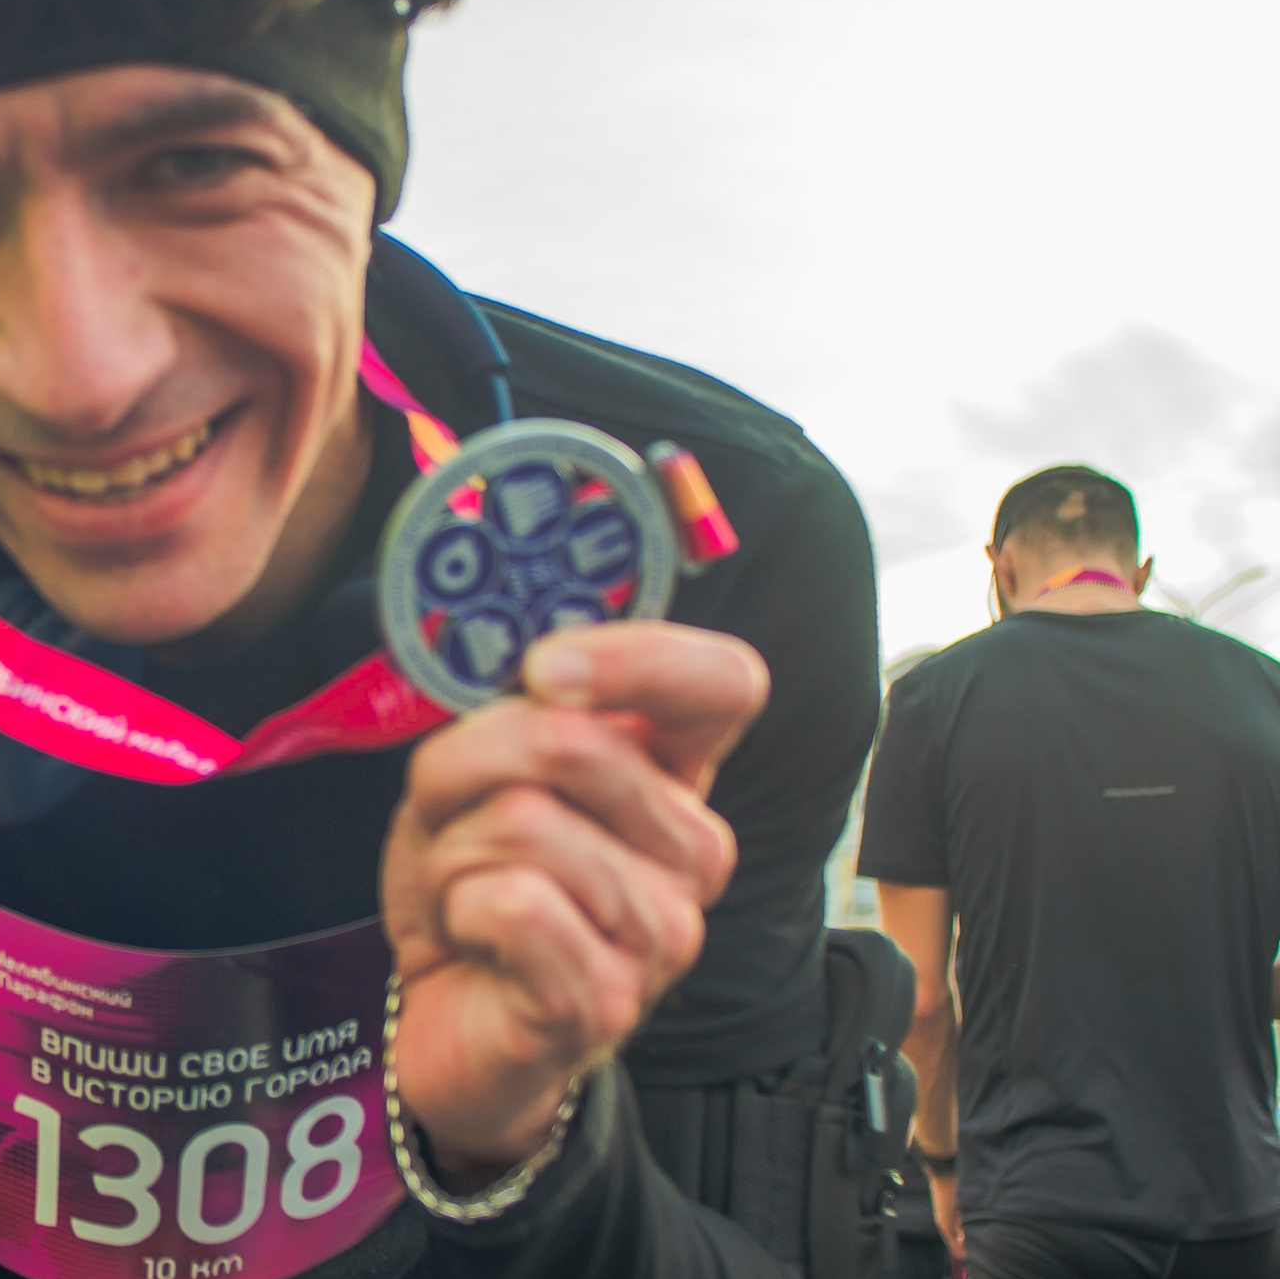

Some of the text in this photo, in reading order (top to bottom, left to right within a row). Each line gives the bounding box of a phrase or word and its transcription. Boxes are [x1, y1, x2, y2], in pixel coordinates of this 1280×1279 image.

[30, 1045, 373, 1112] В ИСТОРИЮ ГОРОДА
[41, 1027, 167, 1078] ВПИШИ
[179, 1042, 271, 1079] СВОЕ
[13, 1093, 365, 1247] 1308
